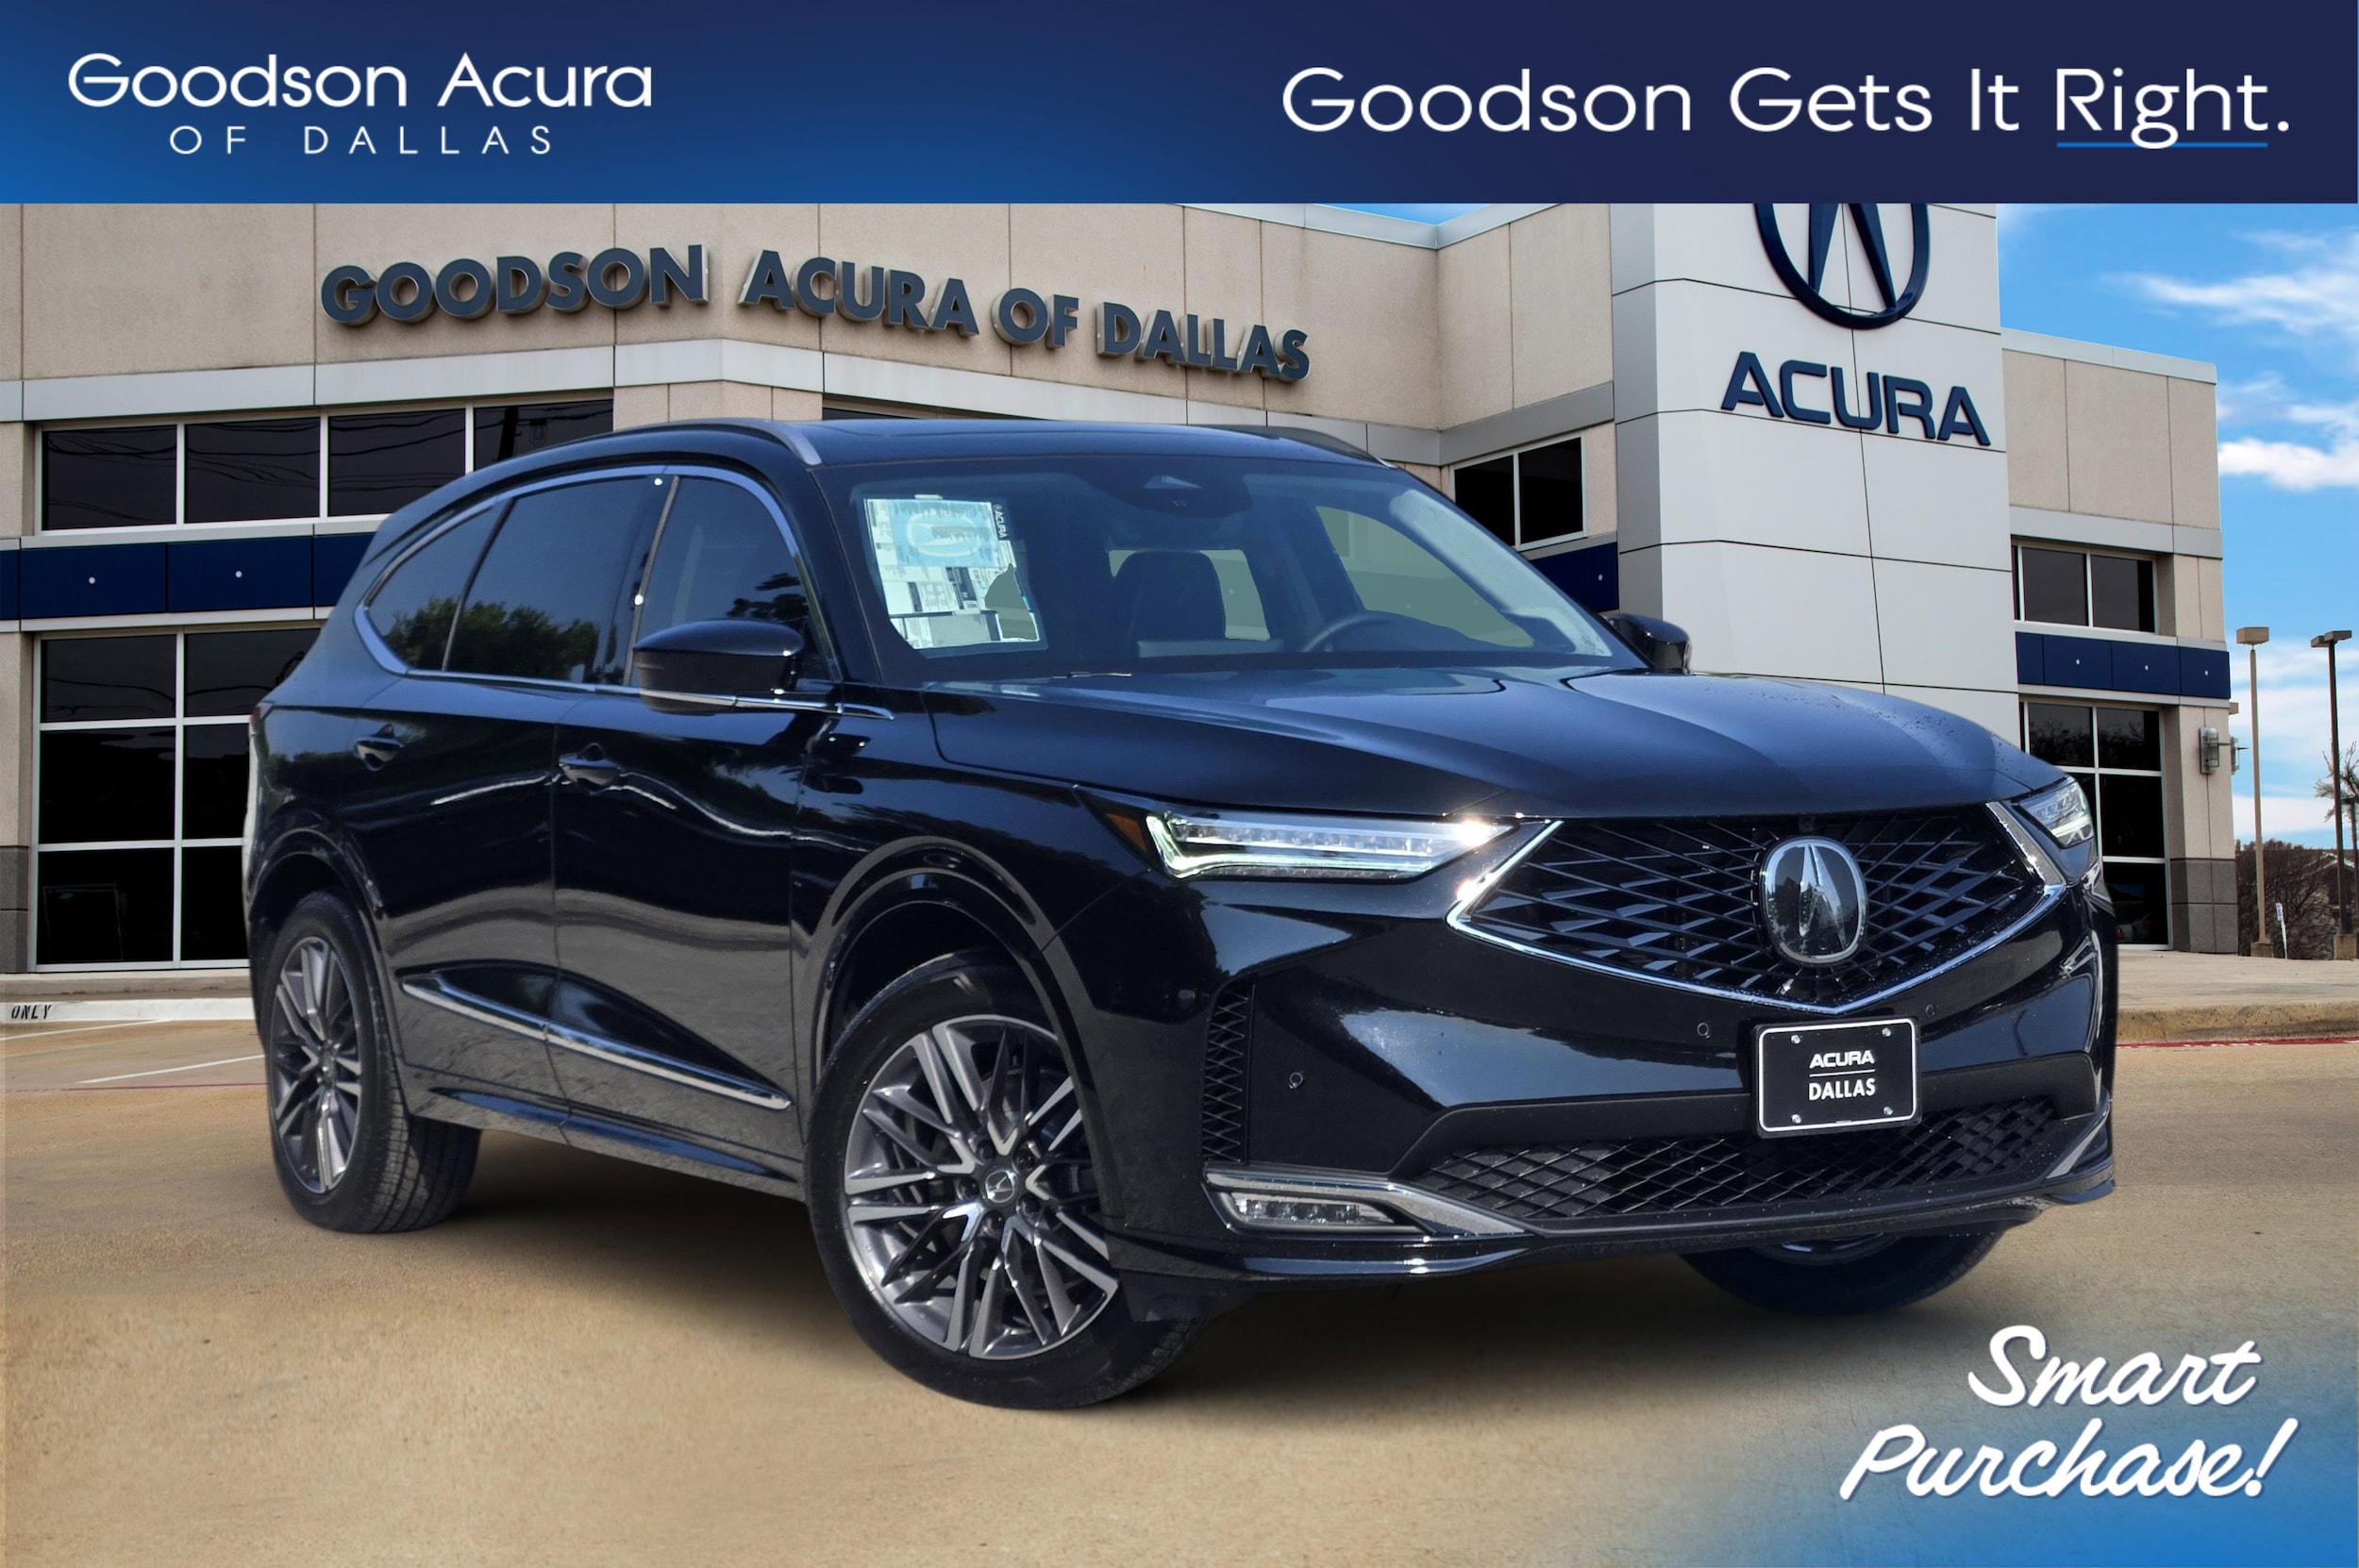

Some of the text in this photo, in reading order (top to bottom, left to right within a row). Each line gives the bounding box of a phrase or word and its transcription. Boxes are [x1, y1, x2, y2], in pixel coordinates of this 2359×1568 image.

[321, 244, 1311, 382] GOODSON ACURA OF DALLAS
[1720, 351, 1991, 447] ACURA
[994, 509, 1008, 539] ACURA
[11, 1004, 52, 1020] ONLY
[1809, 1049, 1876, 1069] ACURA
[1808, 1077, 1877, 1101] DALLAS
